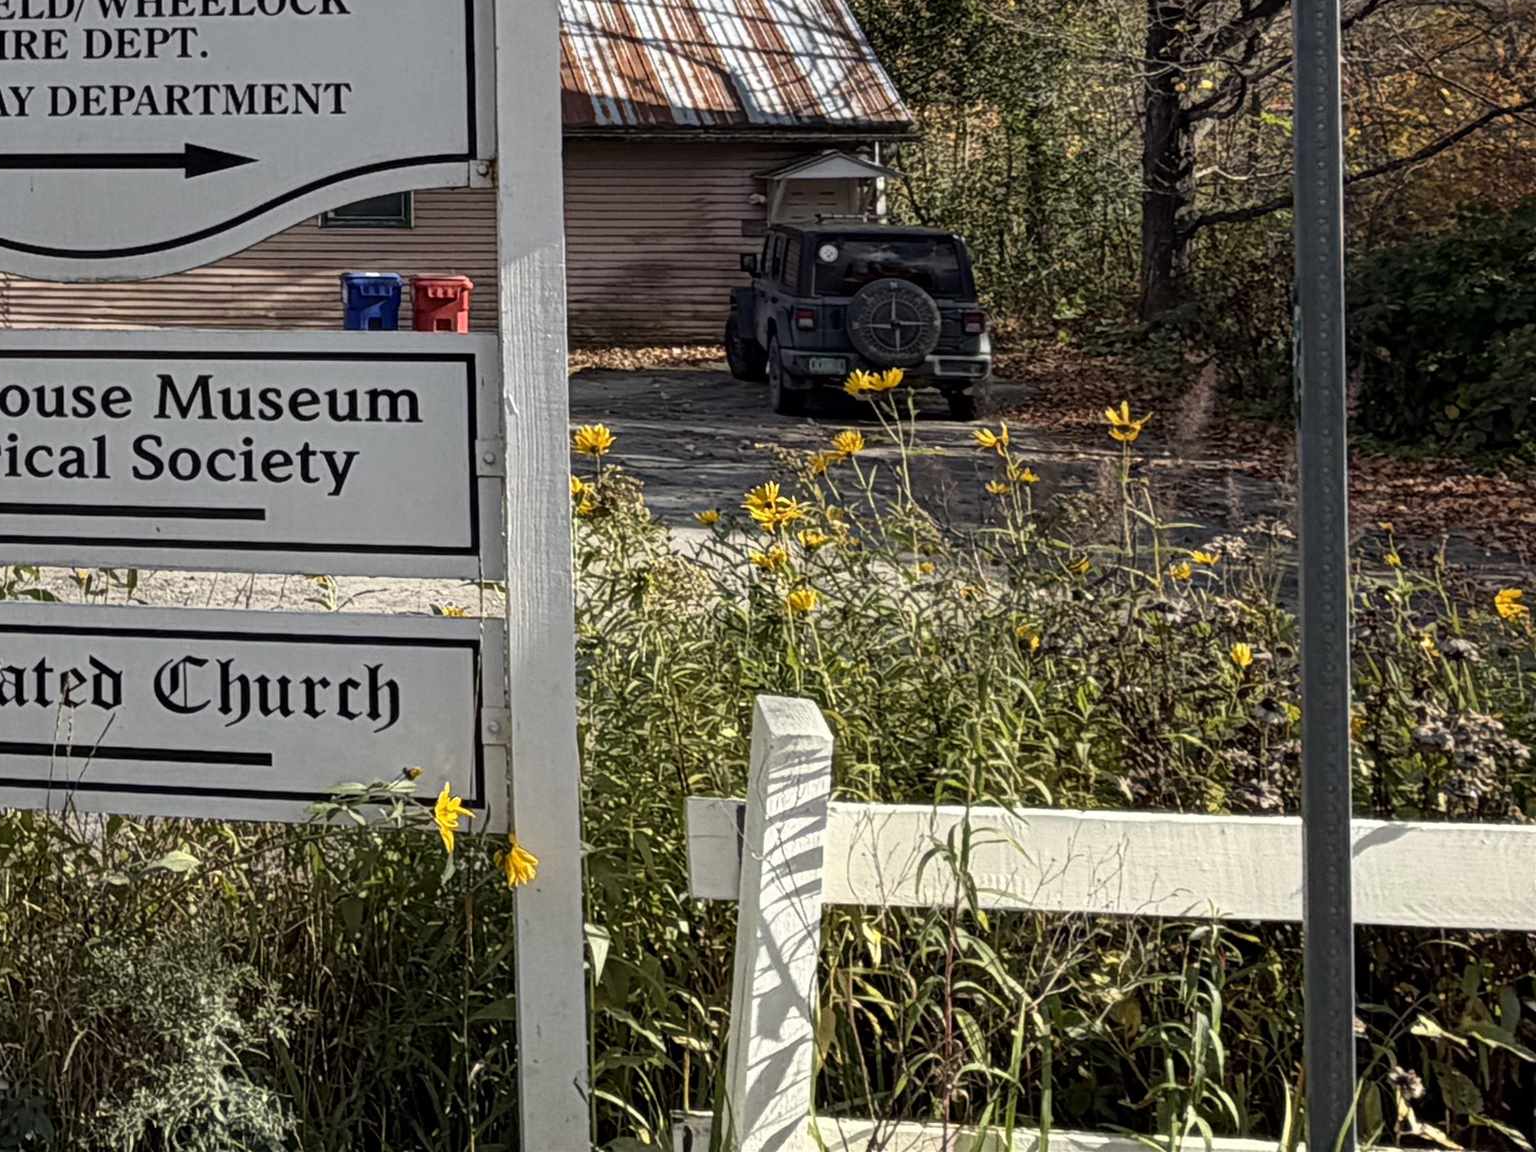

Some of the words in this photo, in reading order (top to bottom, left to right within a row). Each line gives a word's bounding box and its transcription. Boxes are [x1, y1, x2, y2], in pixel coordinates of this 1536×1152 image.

[83, 26, 210, 60] DEPT.
[47, 82, 352, 117] DEPARTMENT
[153, 374, 423, 423] Museum
[132, 434, 360, 497] Society
[153, 655, 400, 734] Church
